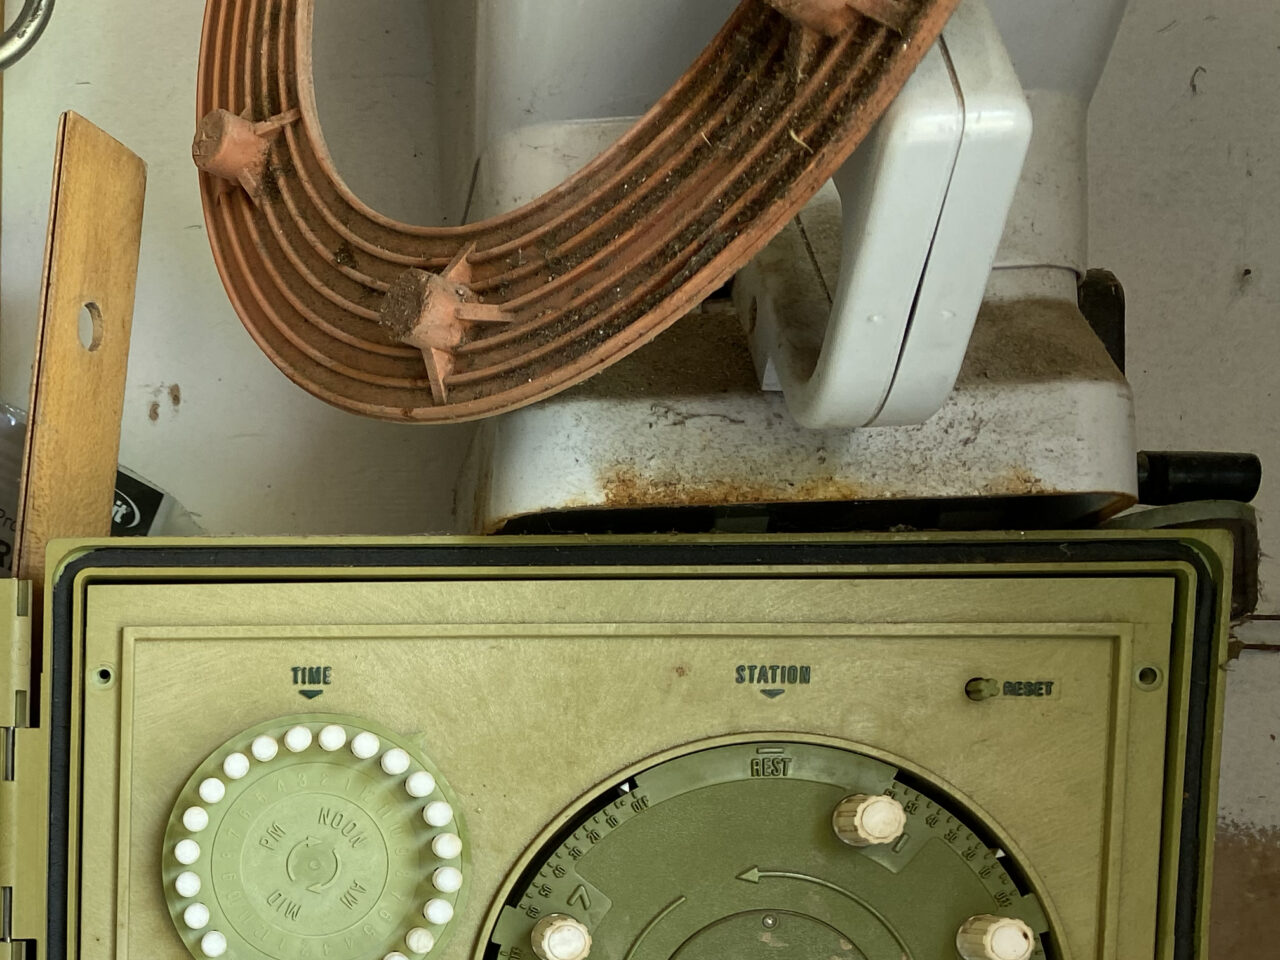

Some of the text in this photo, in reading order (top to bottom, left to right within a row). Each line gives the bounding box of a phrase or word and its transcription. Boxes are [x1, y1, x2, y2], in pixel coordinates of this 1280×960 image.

[291, 667, 332, 685] TIME
[736, 665, 811, 685] STATION
[1003, 681, 1054, 696] RESET
[751, 758, 792, 777] REST
